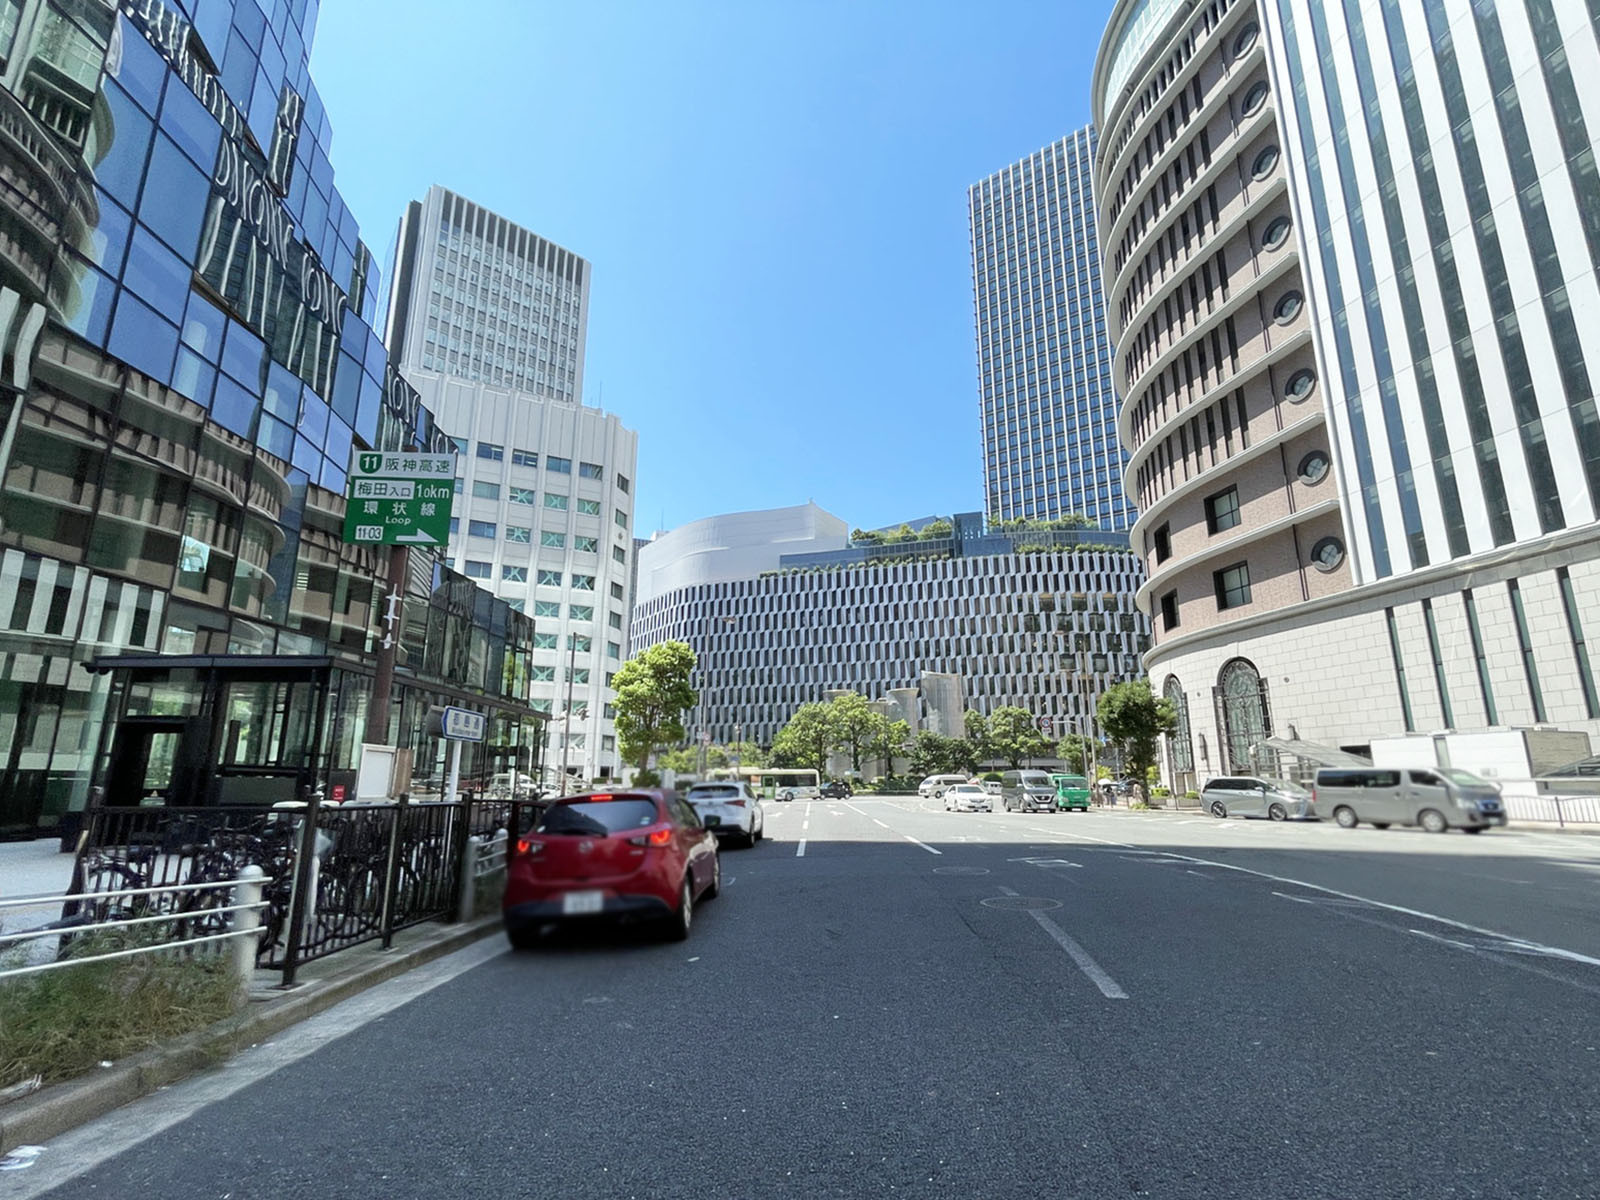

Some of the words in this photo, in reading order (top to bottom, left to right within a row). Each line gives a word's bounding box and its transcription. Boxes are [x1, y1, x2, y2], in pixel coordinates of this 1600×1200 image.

[363, 456, 378, 469] 11
[385, 458, 450, 473] 阪神高速
[358, 482, 411, 497] 梅田入口
[385, 516, 411, 525] Loop
